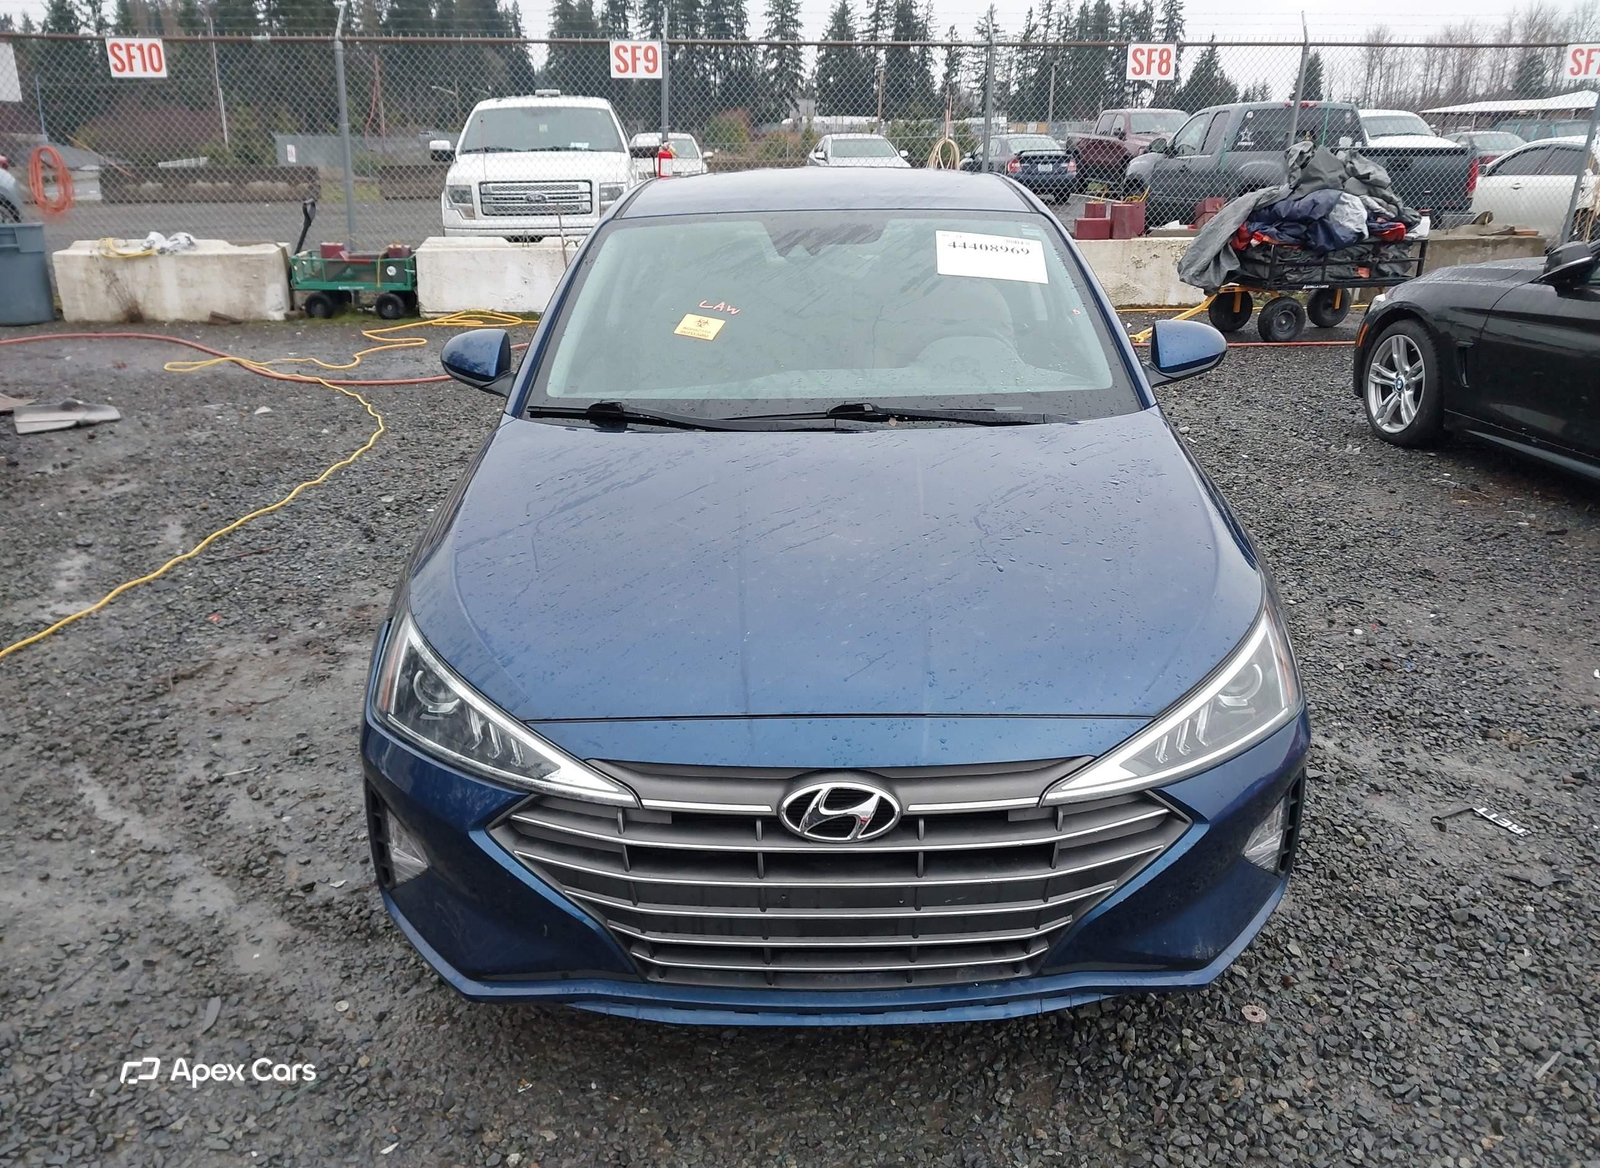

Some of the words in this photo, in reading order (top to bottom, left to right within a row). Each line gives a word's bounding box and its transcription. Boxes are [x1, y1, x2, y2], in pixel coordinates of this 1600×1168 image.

[109, 42, 163, 72] SF10
[614, 44, 658, 74] SF9
[1131, 47, 1172, 76] SF8
[948, 241, 1030, 255] 44408969
[698, 299, 741, 315] LAW
